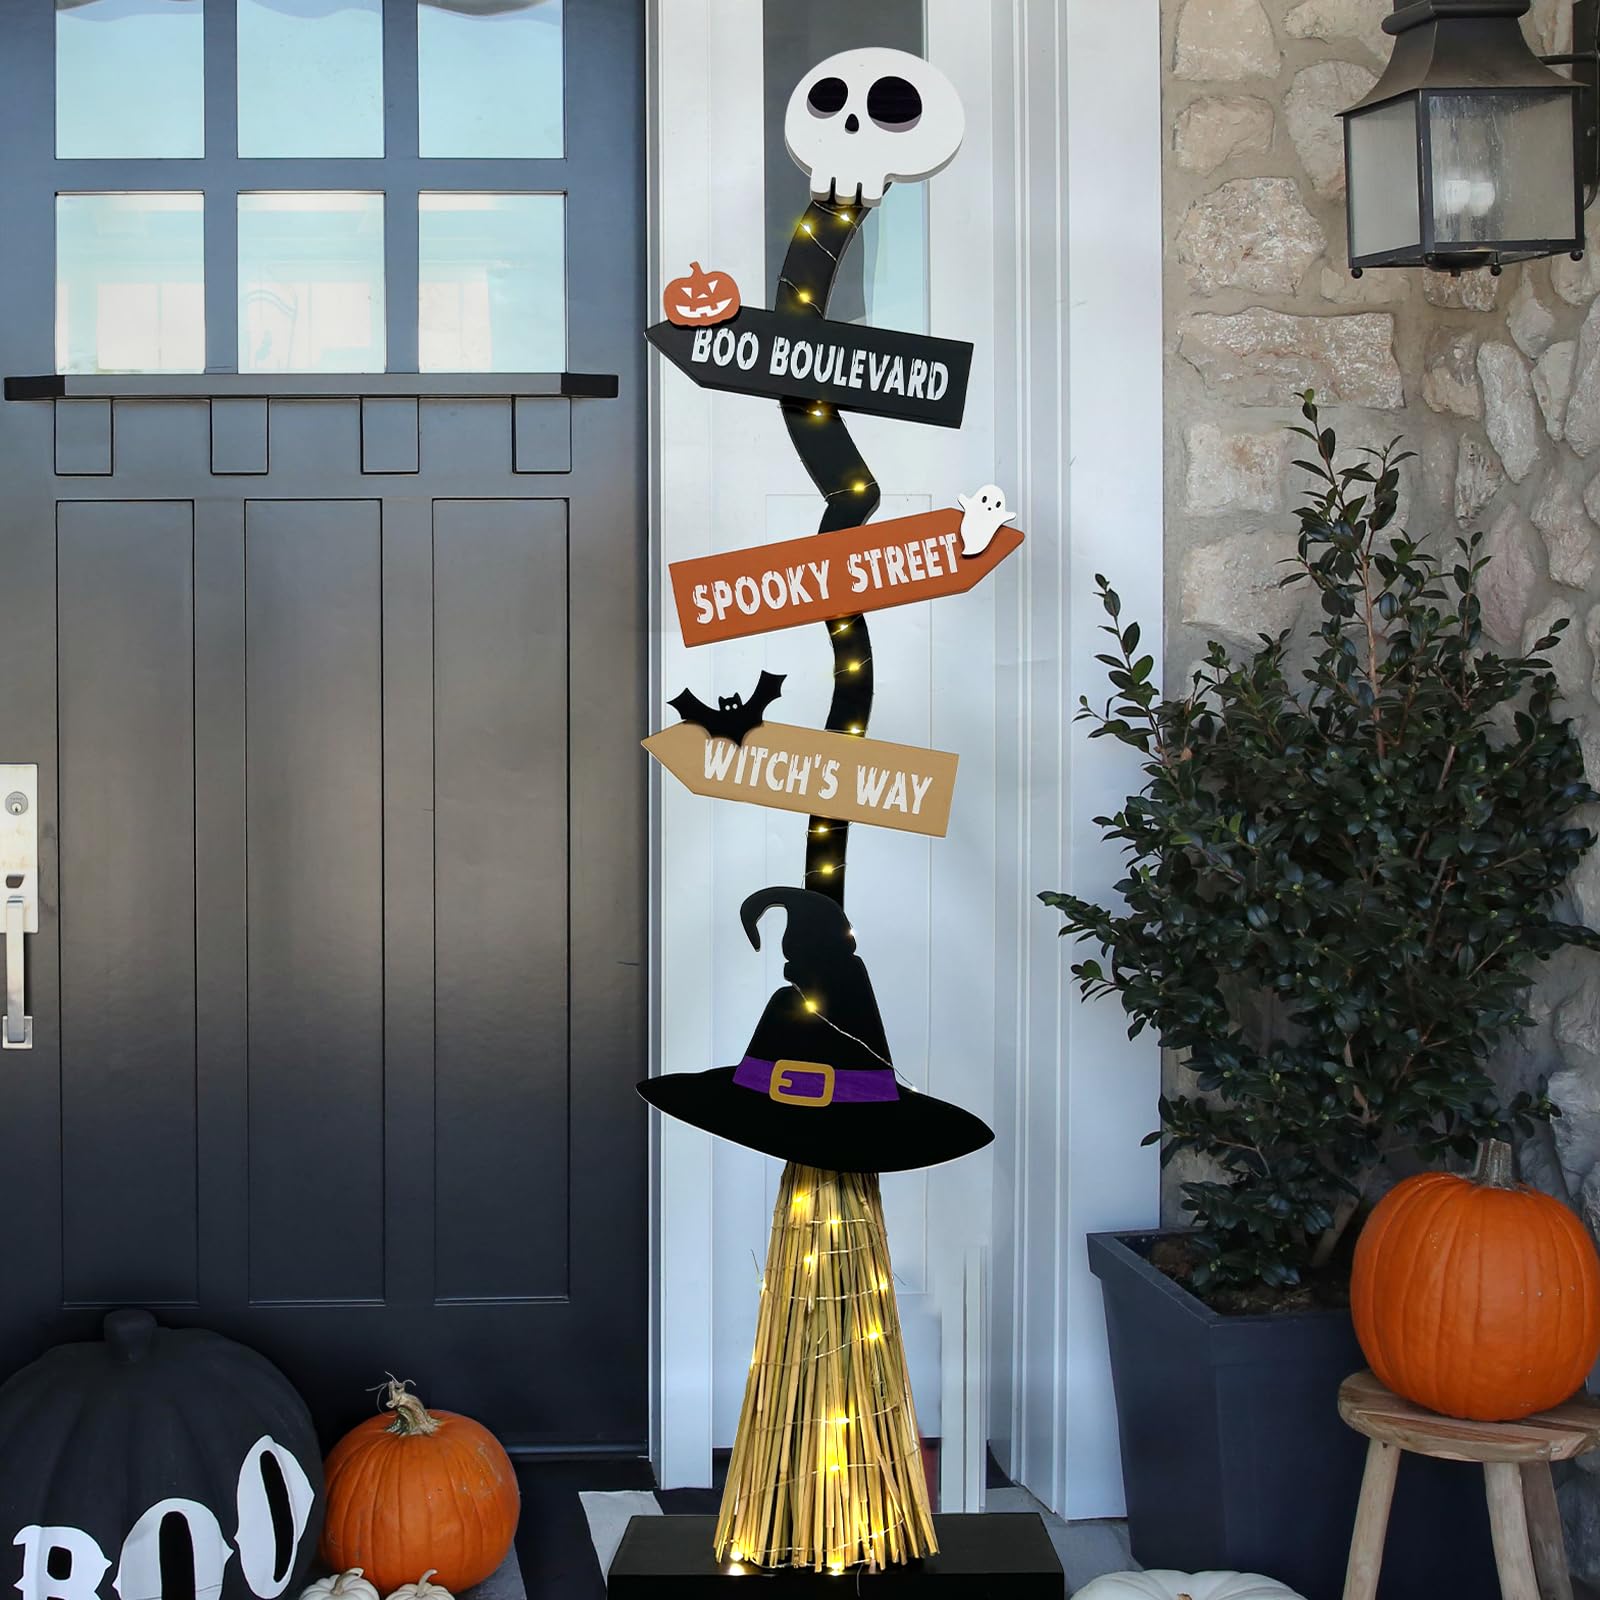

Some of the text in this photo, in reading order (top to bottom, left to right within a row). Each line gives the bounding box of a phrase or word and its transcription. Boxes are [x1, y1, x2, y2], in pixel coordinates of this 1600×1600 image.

[691, 327, 948, 400] BOO BOULEVARD
[692, 533, 958, 624] SPOOKY STREET
[704, 740, 933, 814] WITCH'S WAY
